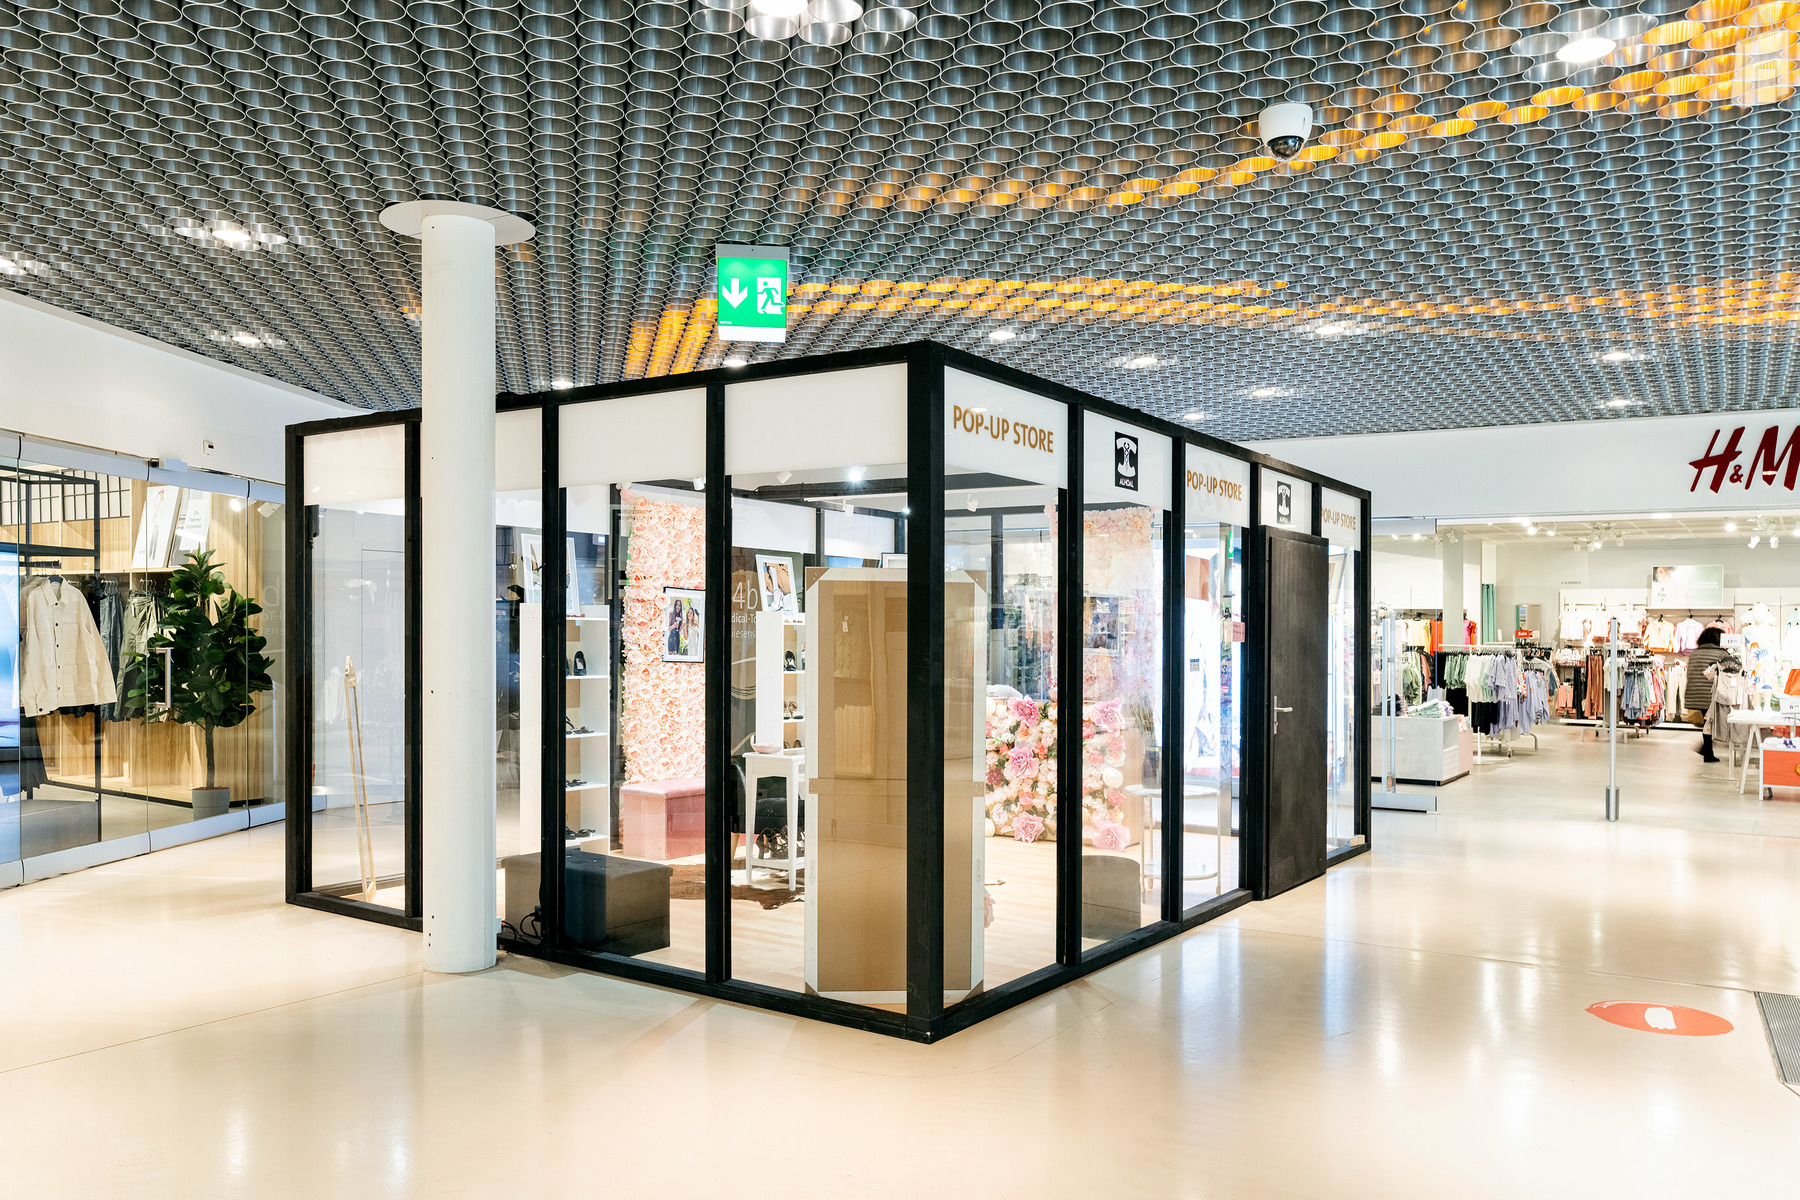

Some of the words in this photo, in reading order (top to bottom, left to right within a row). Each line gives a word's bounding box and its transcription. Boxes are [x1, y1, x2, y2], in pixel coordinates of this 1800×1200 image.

[953, 405, 1010, 441] POP-UP
[1013, 422, 1054, 454] STORE
[1688, 425, 1800, 494] H&M
[1186, 469, 1218, 495] POP-UP
[1219, 479, 1242, 501] STORE
[1340, 513, 1356, 530] STORE
